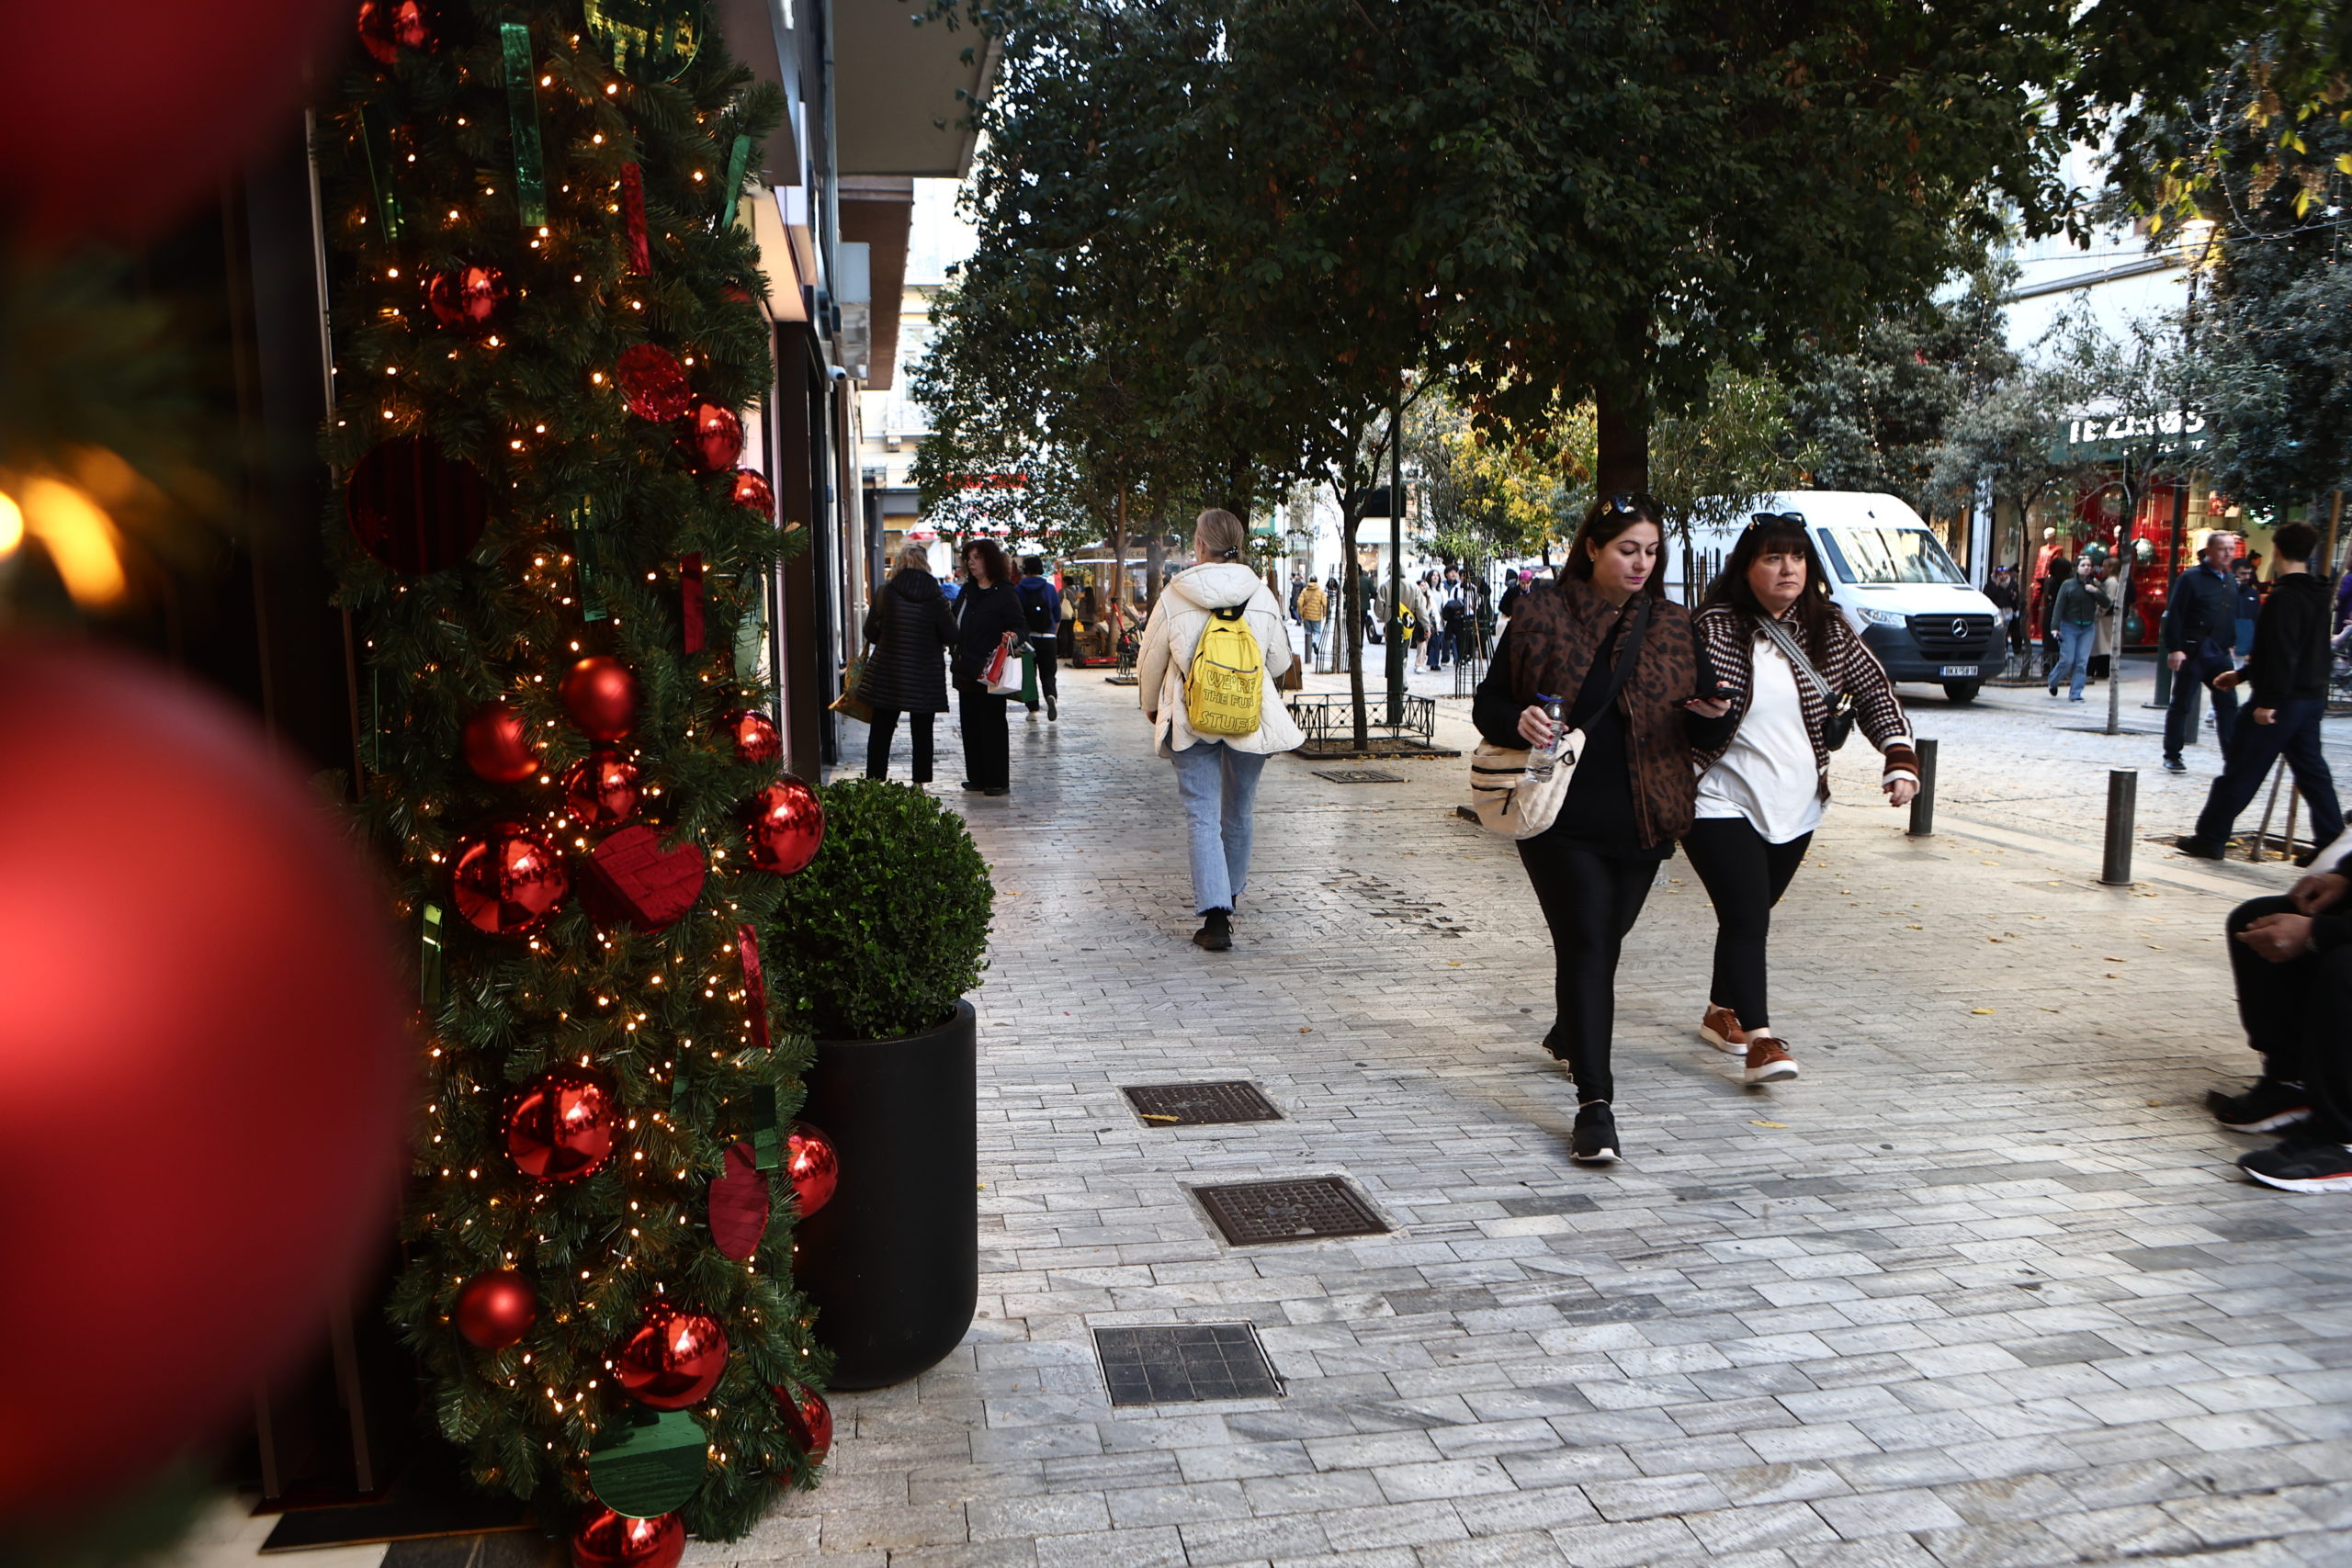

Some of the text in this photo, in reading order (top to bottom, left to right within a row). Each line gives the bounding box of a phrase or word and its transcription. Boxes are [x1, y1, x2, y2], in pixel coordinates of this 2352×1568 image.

[1204, 689, 1253, 708] THE FUN
[1200, 711, 1256, 731] STUFF
